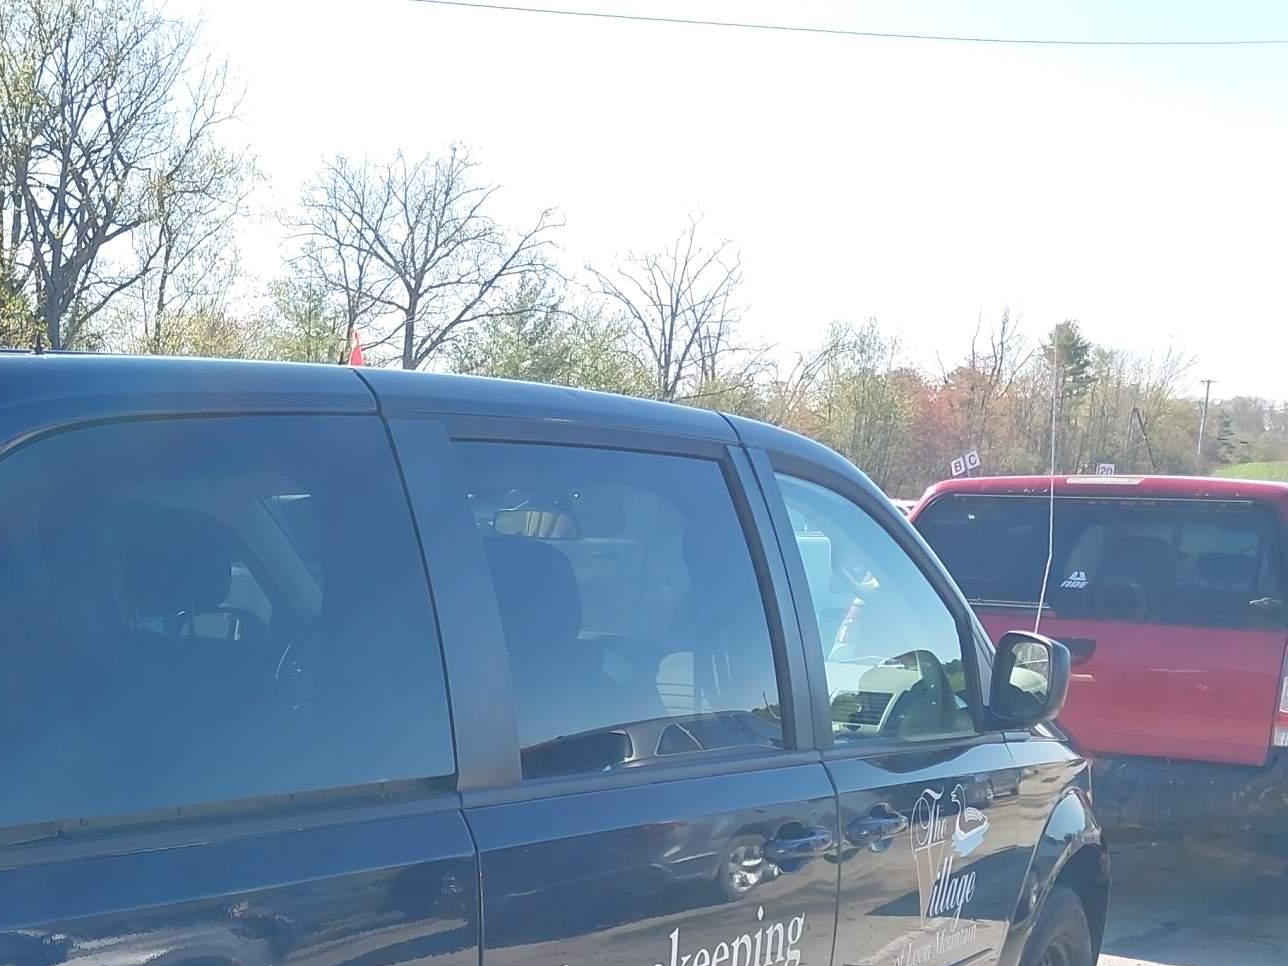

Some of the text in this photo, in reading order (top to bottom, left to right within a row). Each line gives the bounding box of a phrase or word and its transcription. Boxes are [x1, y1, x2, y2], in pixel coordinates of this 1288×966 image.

[953, 454, 977, 473] B C
[911, 786, 947, 847] The
[914, 841, 976, 932] Village
